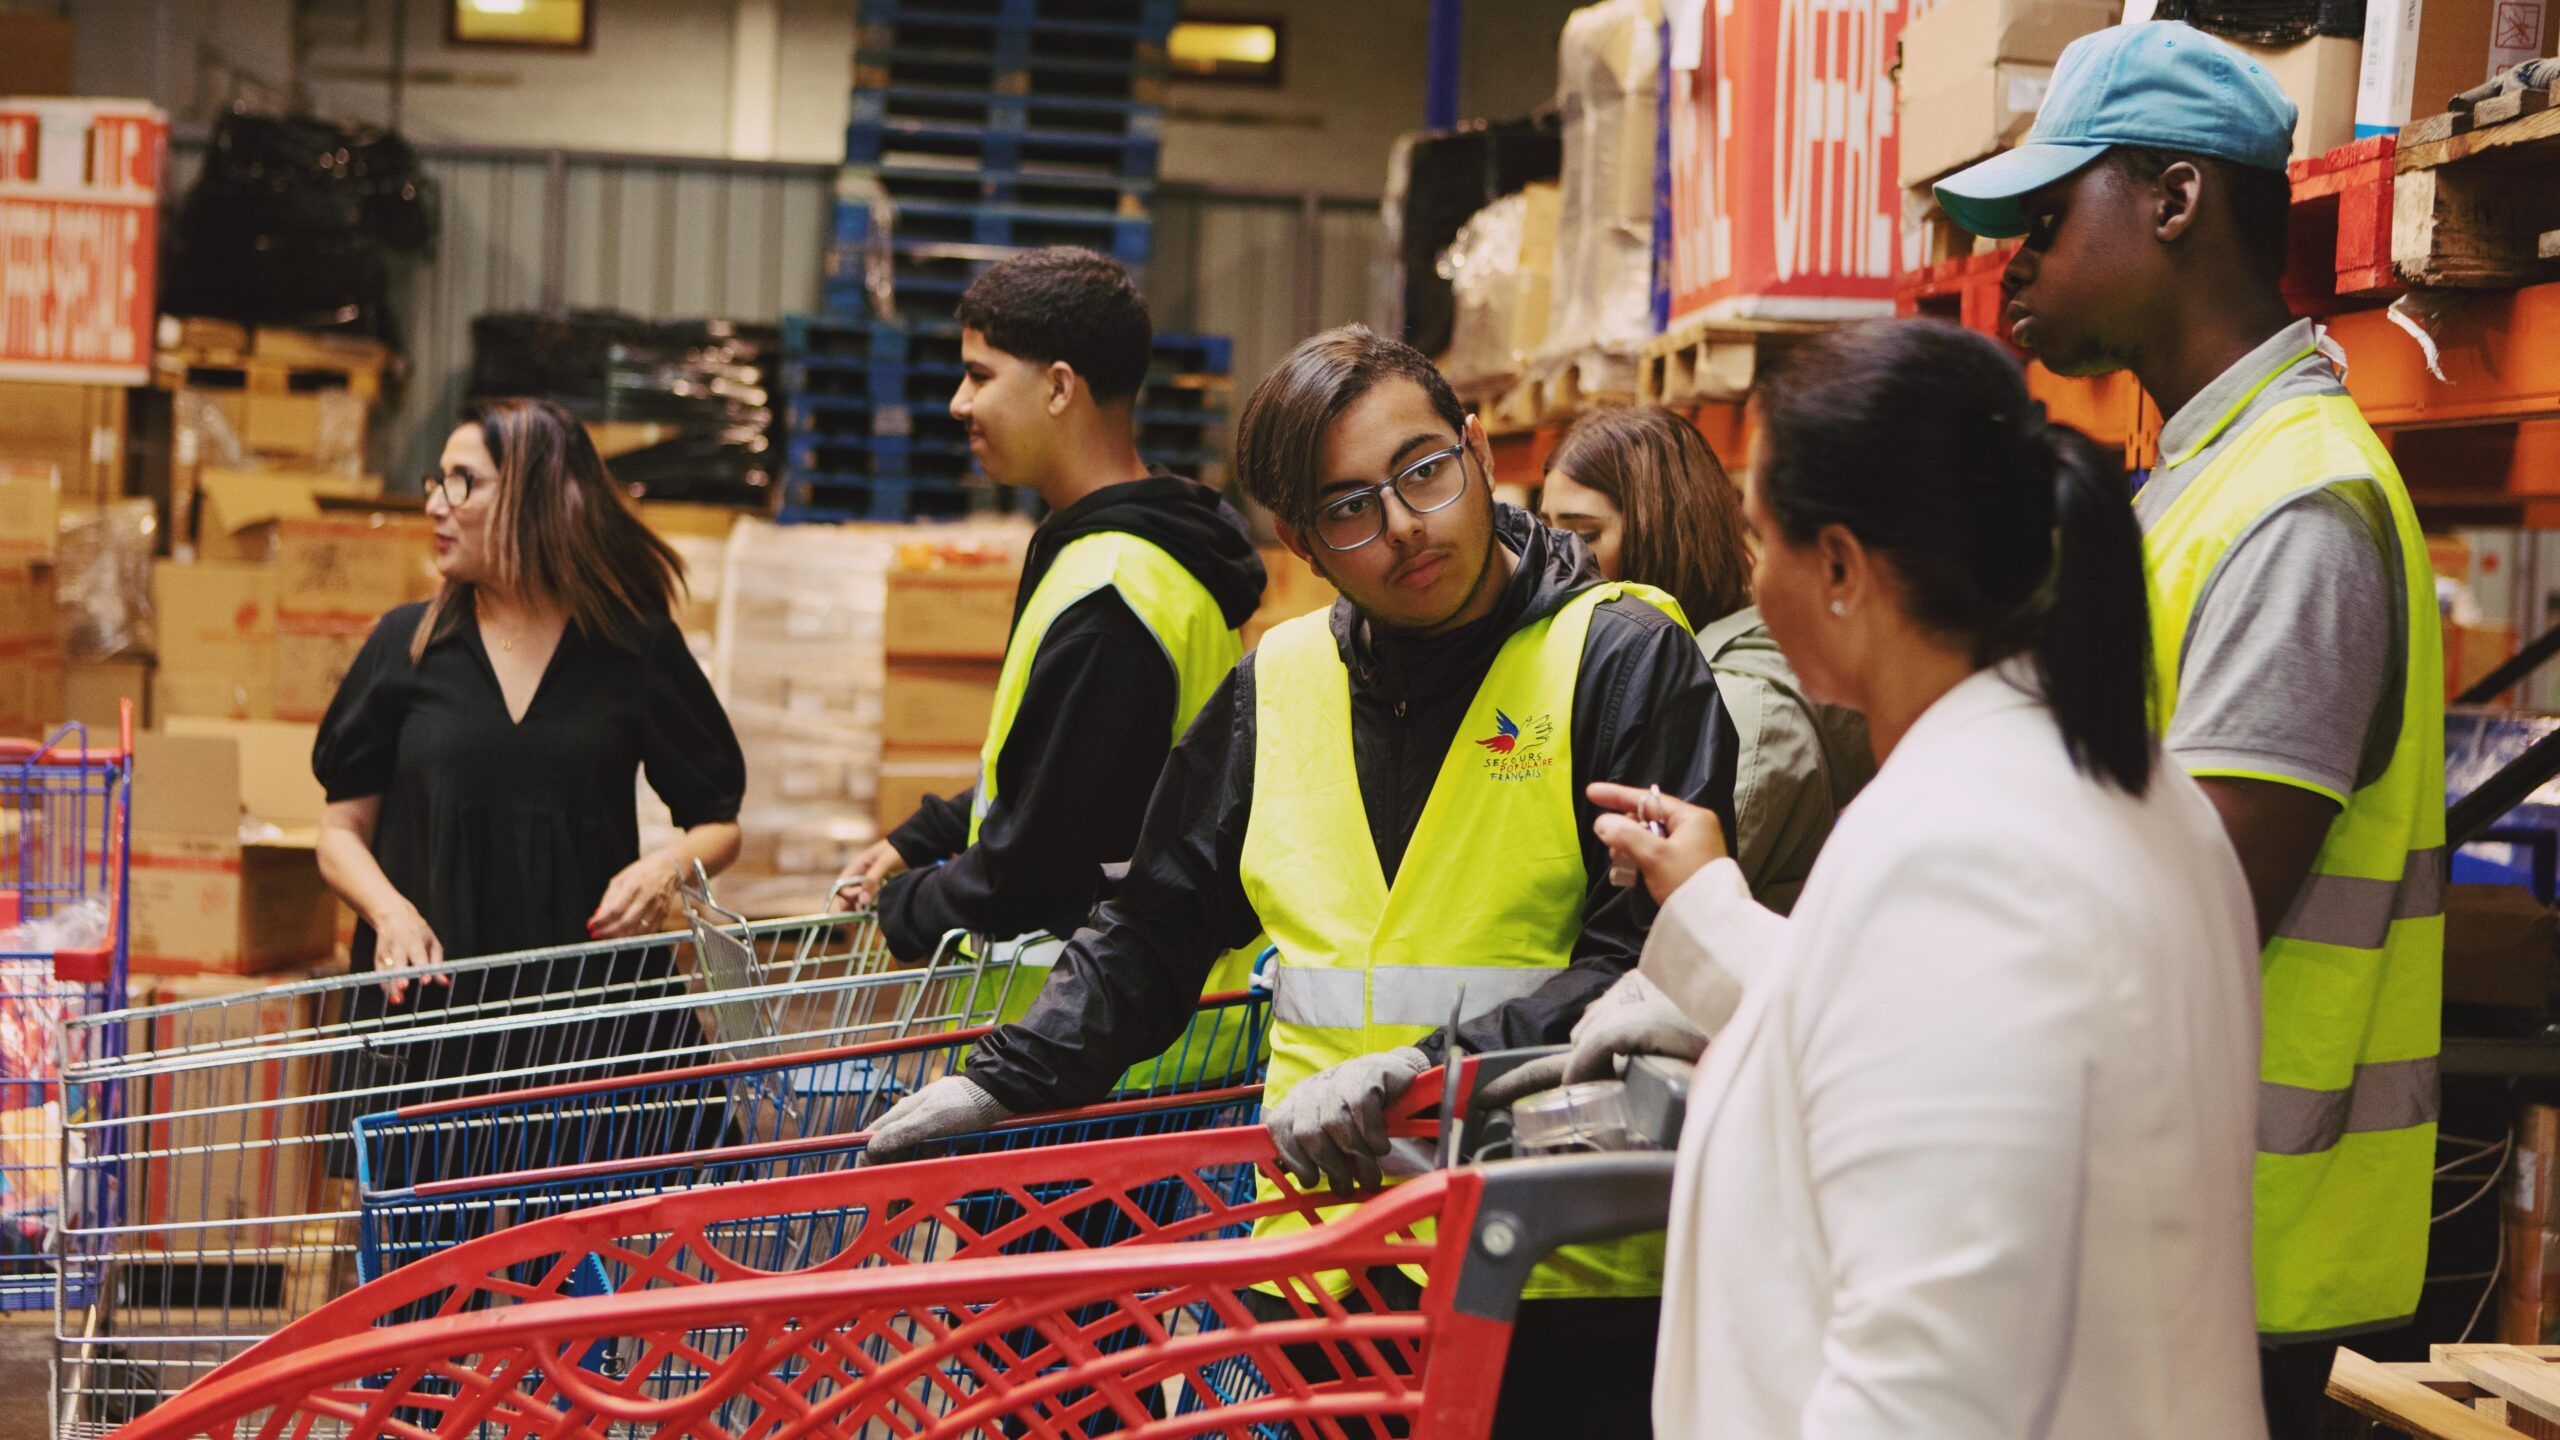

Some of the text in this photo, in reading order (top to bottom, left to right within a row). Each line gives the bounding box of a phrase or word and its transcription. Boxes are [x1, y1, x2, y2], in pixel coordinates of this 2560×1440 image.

[1772, 0, 1897, 284] OFFRE
[1483, 753, 1541, 767] SECOURS
[1500, 758, 1552, 773] POPULAIRE
[1490, 769, 1541, 781] FRANÇAIS
